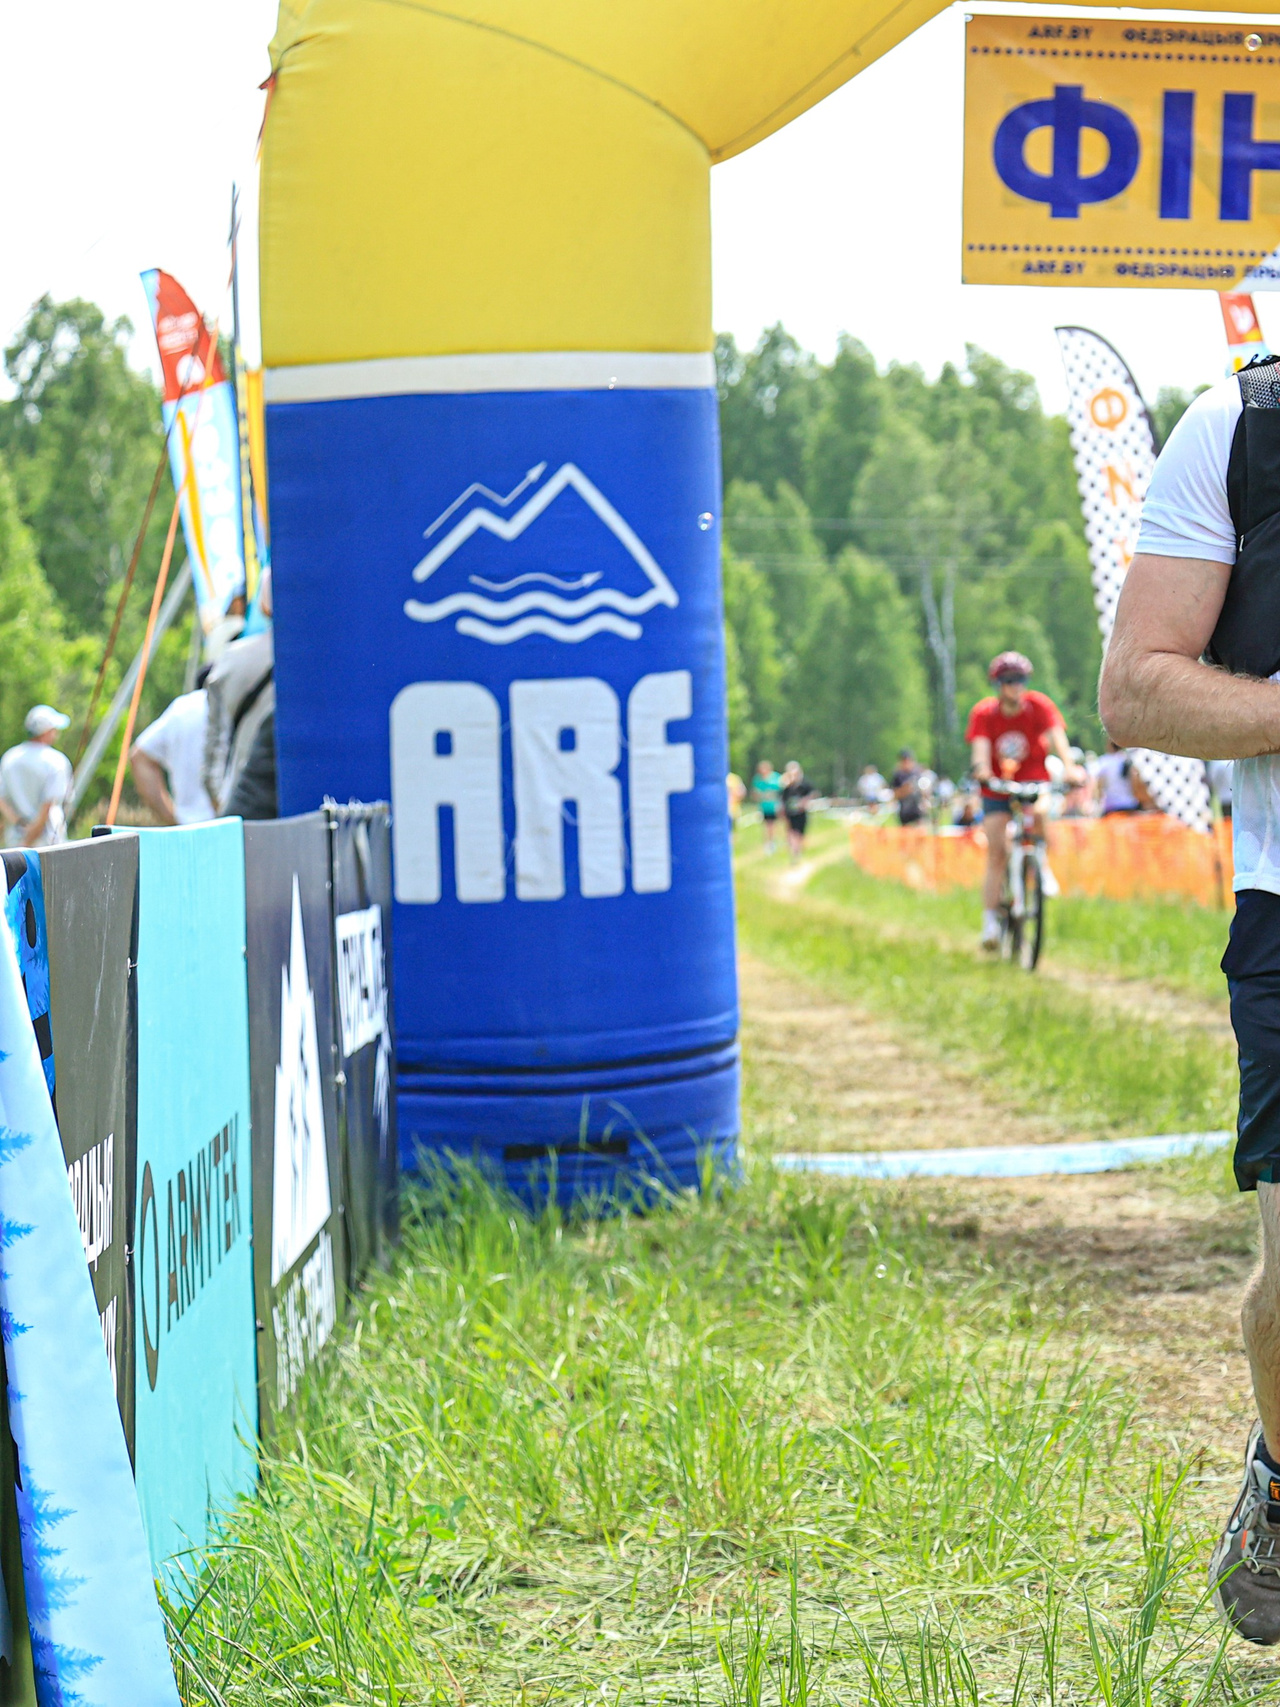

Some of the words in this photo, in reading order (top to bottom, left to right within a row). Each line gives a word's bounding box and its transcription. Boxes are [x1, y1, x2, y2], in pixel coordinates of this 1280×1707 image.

[1028, 25, 1093, 41] ARF.BY
[1021, 261, 1086, 276] ARF.BY
[388, 669, 695, 905] ARF
[167, 1111, 242, 1334] ARMYTEK
